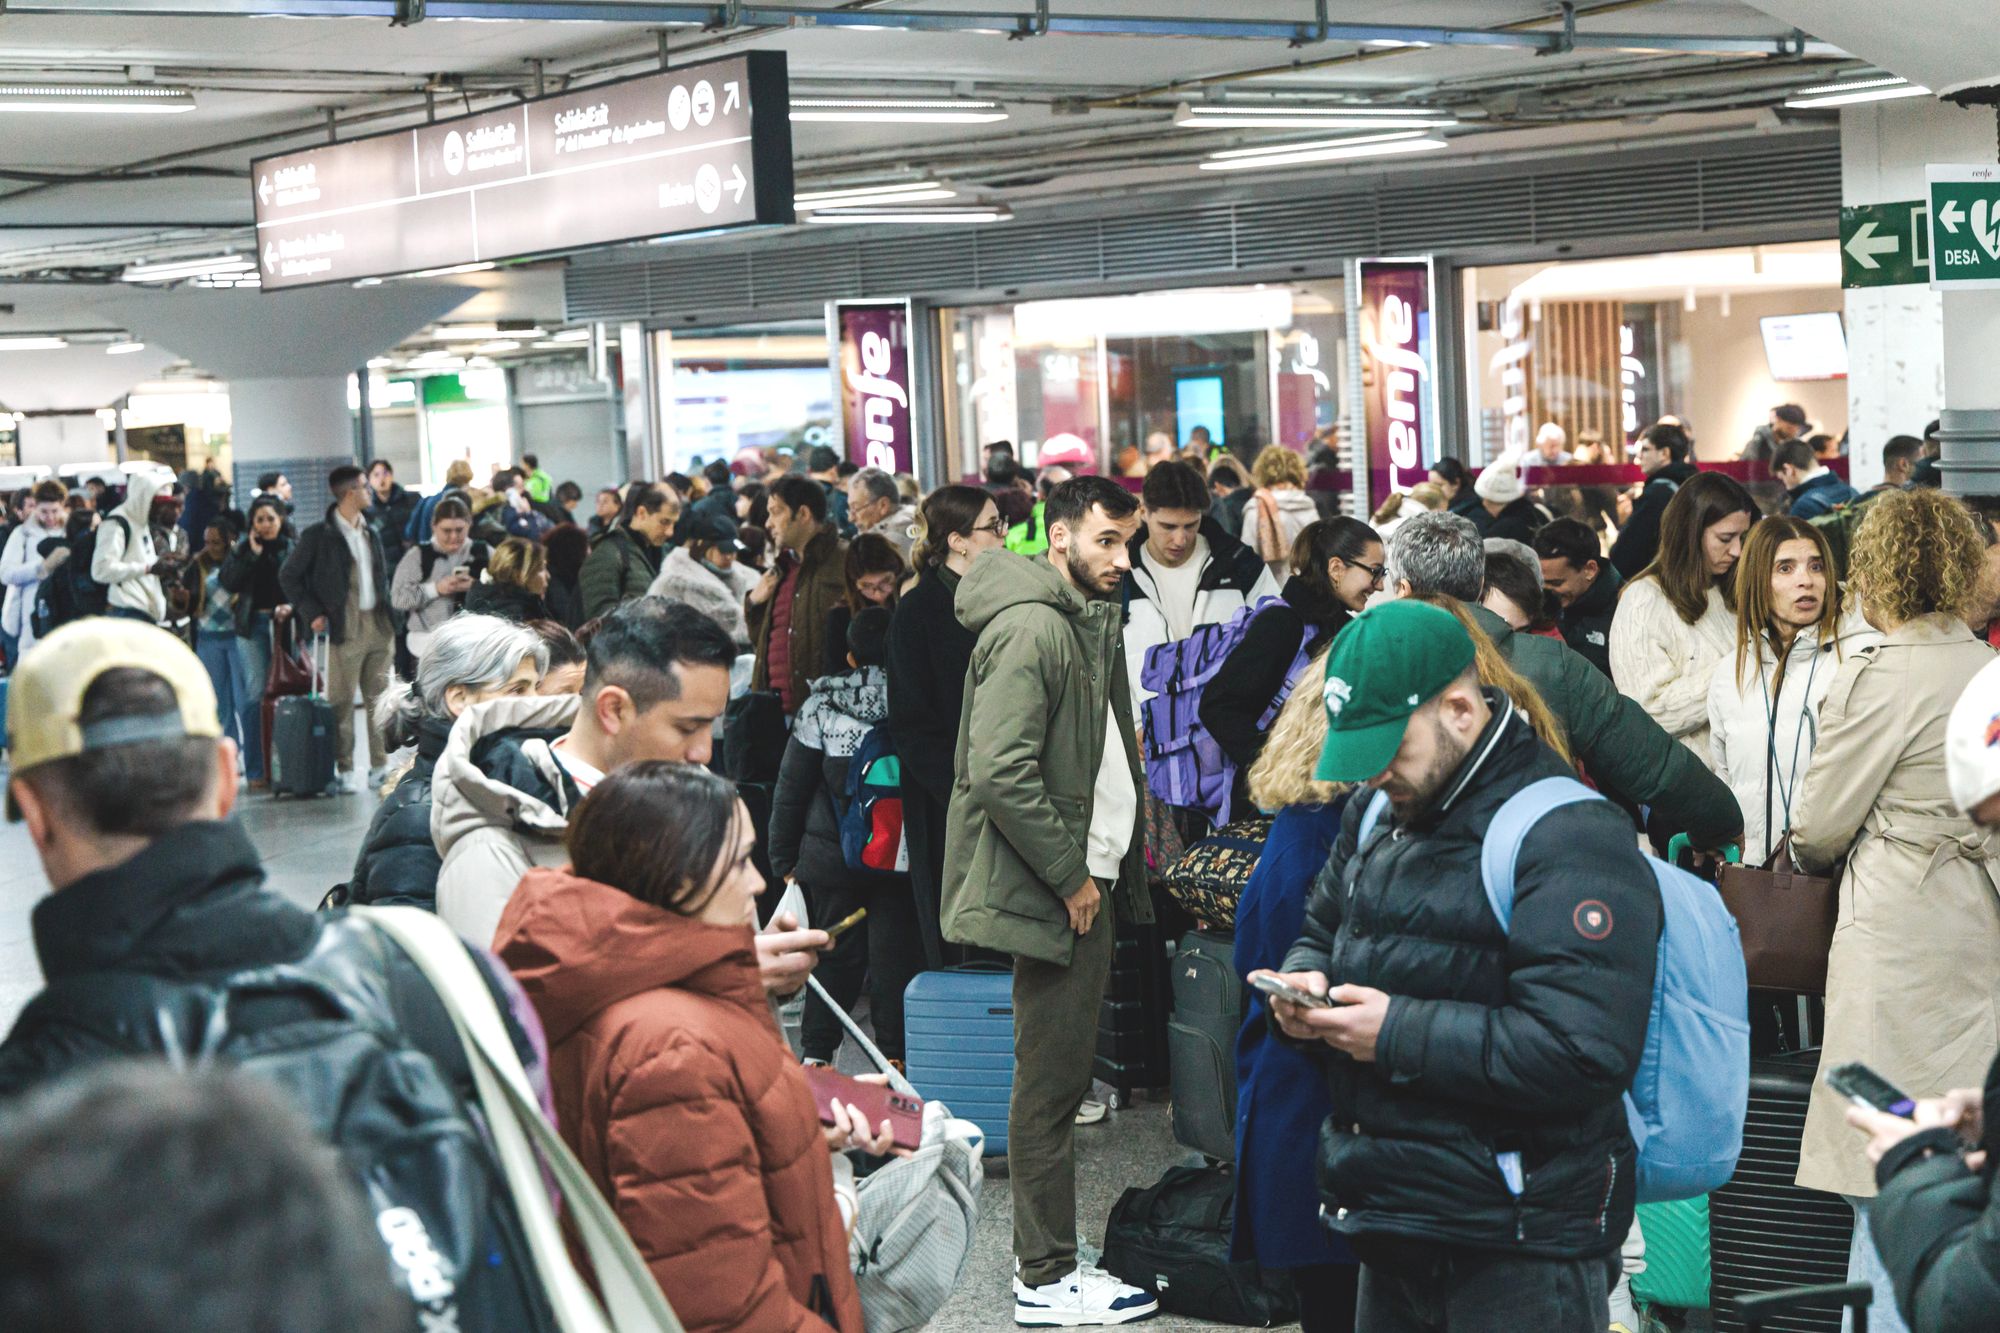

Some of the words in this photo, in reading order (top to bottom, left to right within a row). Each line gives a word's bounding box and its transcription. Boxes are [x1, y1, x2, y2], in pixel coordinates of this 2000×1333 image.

[1972, 167, 1993, 179] renfe
[1944, 248, 1981, 266] DESA
[846, 331, 908, 476] enfe
[1365, 294, 1429, 496] renfe
